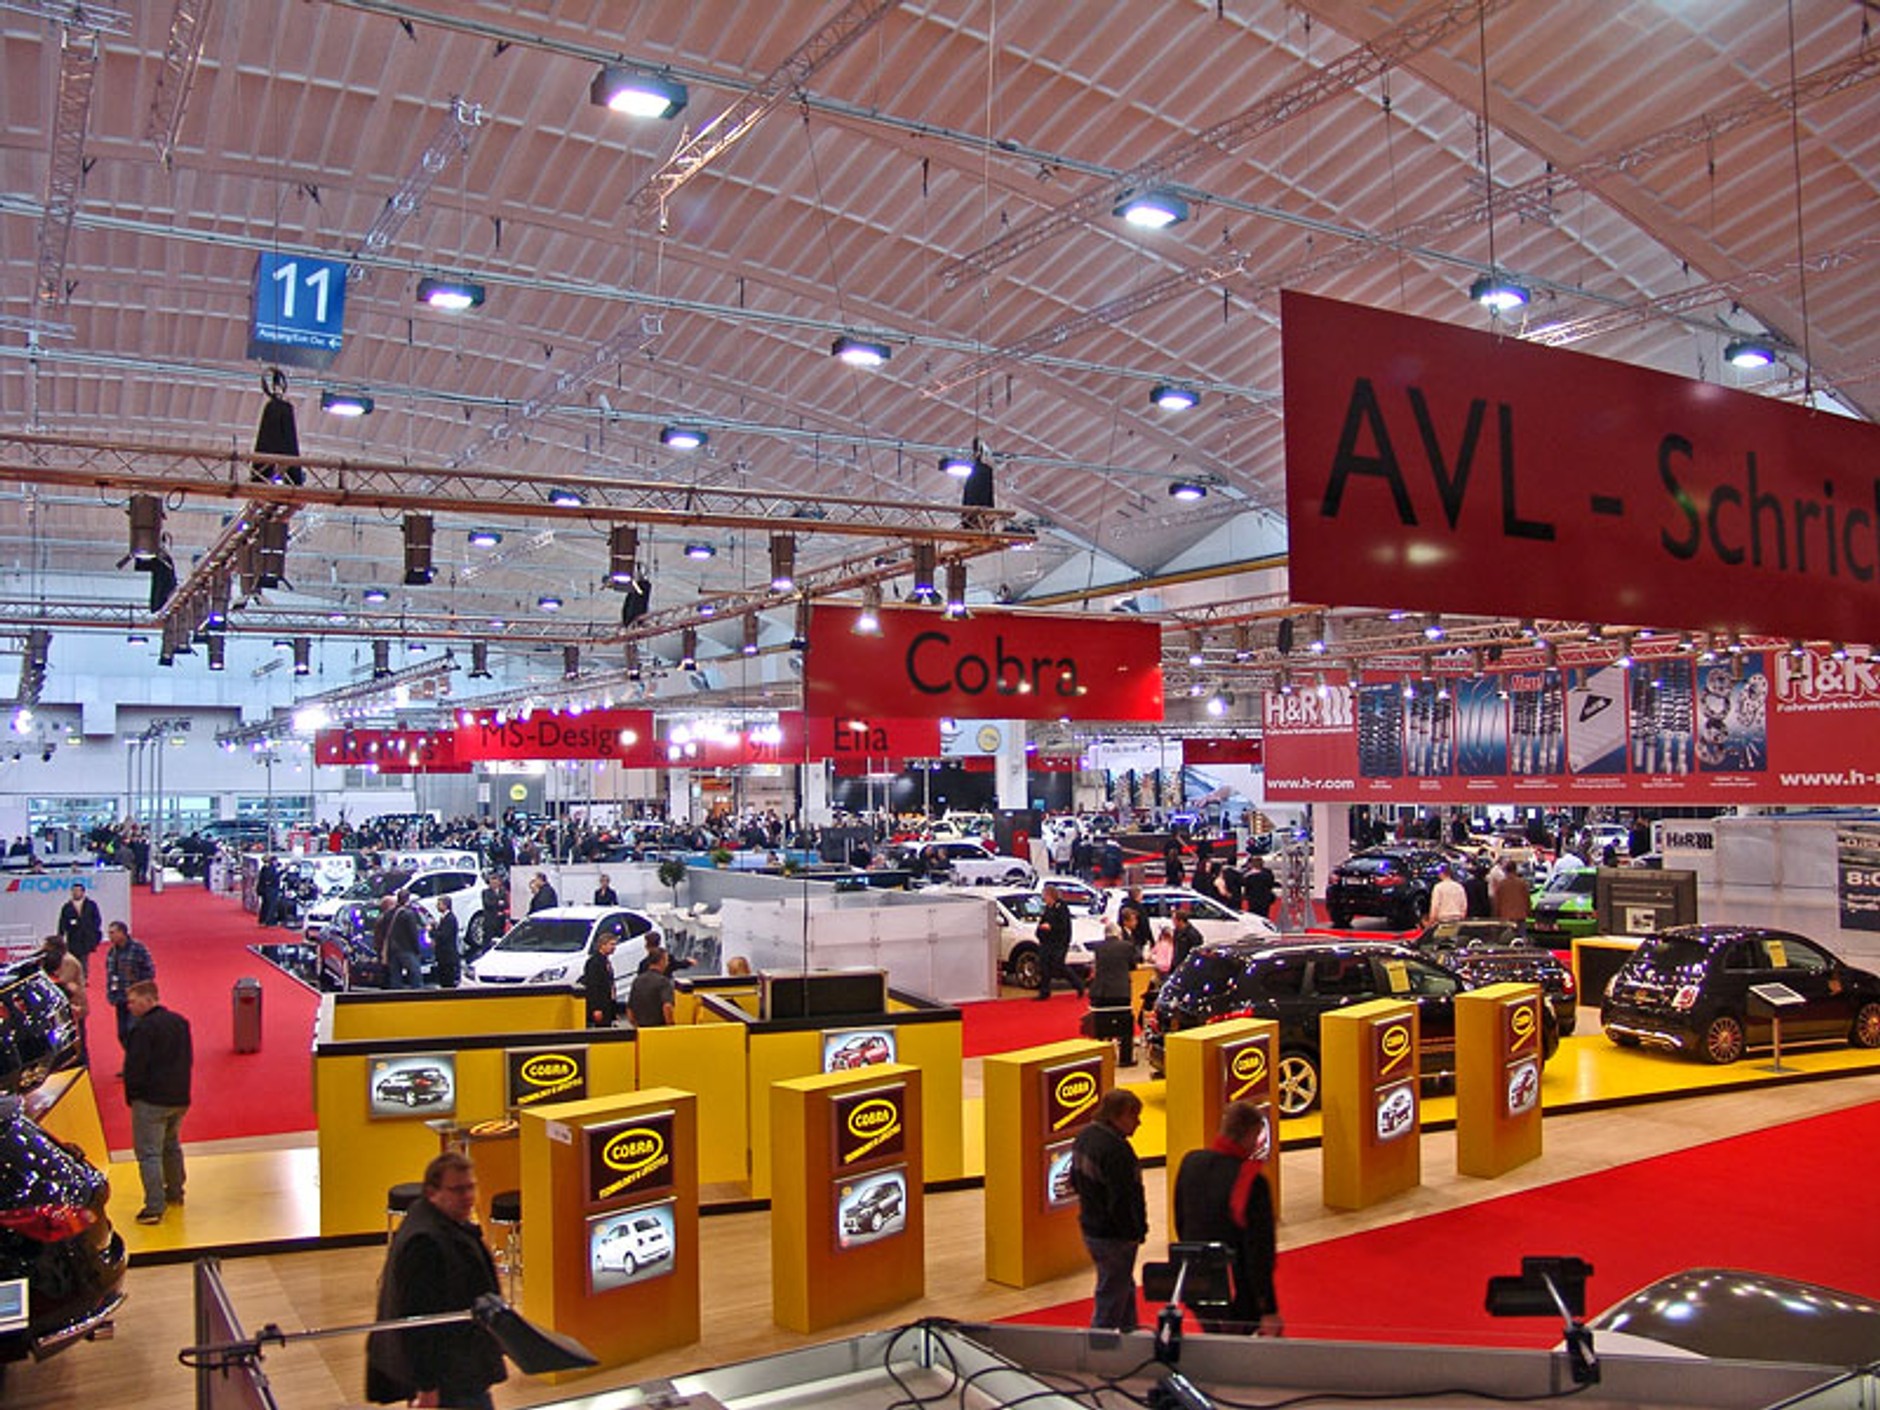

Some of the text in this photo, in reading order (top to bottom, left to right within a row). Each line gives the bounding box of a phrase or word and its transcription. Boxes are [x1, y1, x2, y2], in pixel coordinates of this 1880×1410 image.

[272, 262, 331, 323] 11
[1320, 377, 1880, 584] AVL - Schric
[906, 631, 1079, 697] Cobra
[1265, 684, 1317, 727] H&R
[1267, 777, 1355, 789] www.h-r.com
[855, 1109, 890, 1128] COBRA
[612, 1140, 655, 1160] COBRA
